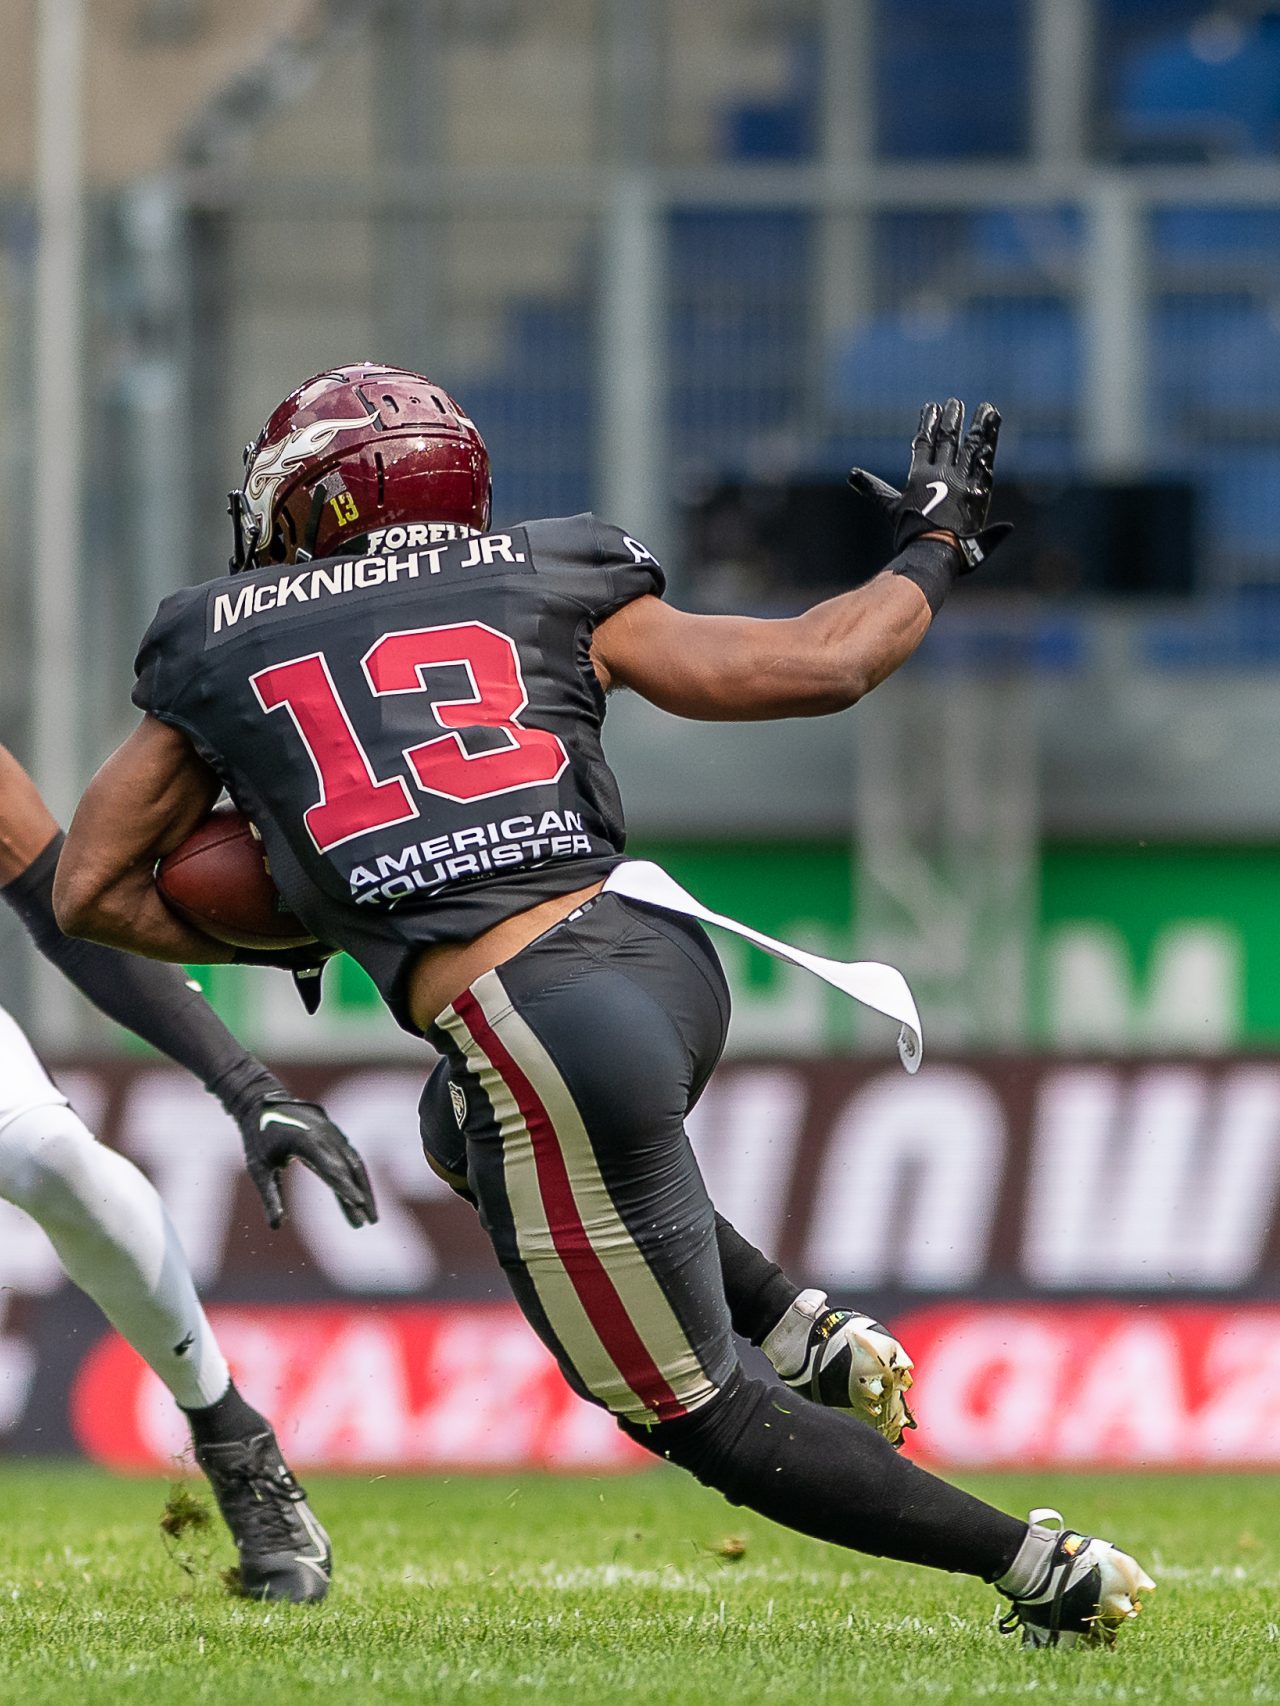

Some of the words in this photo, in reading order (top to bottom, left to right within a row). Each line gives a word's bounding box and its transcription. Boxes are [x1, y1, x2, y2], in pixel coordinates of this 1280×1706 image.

[329, 491, 360, 527] 13
[460, 534, 526, 568] JR.
[248, 620, 571, 855] 13
[349, 809, 583, 896] AMERICAN
[355, 834, 593, 906] TOURISTER
